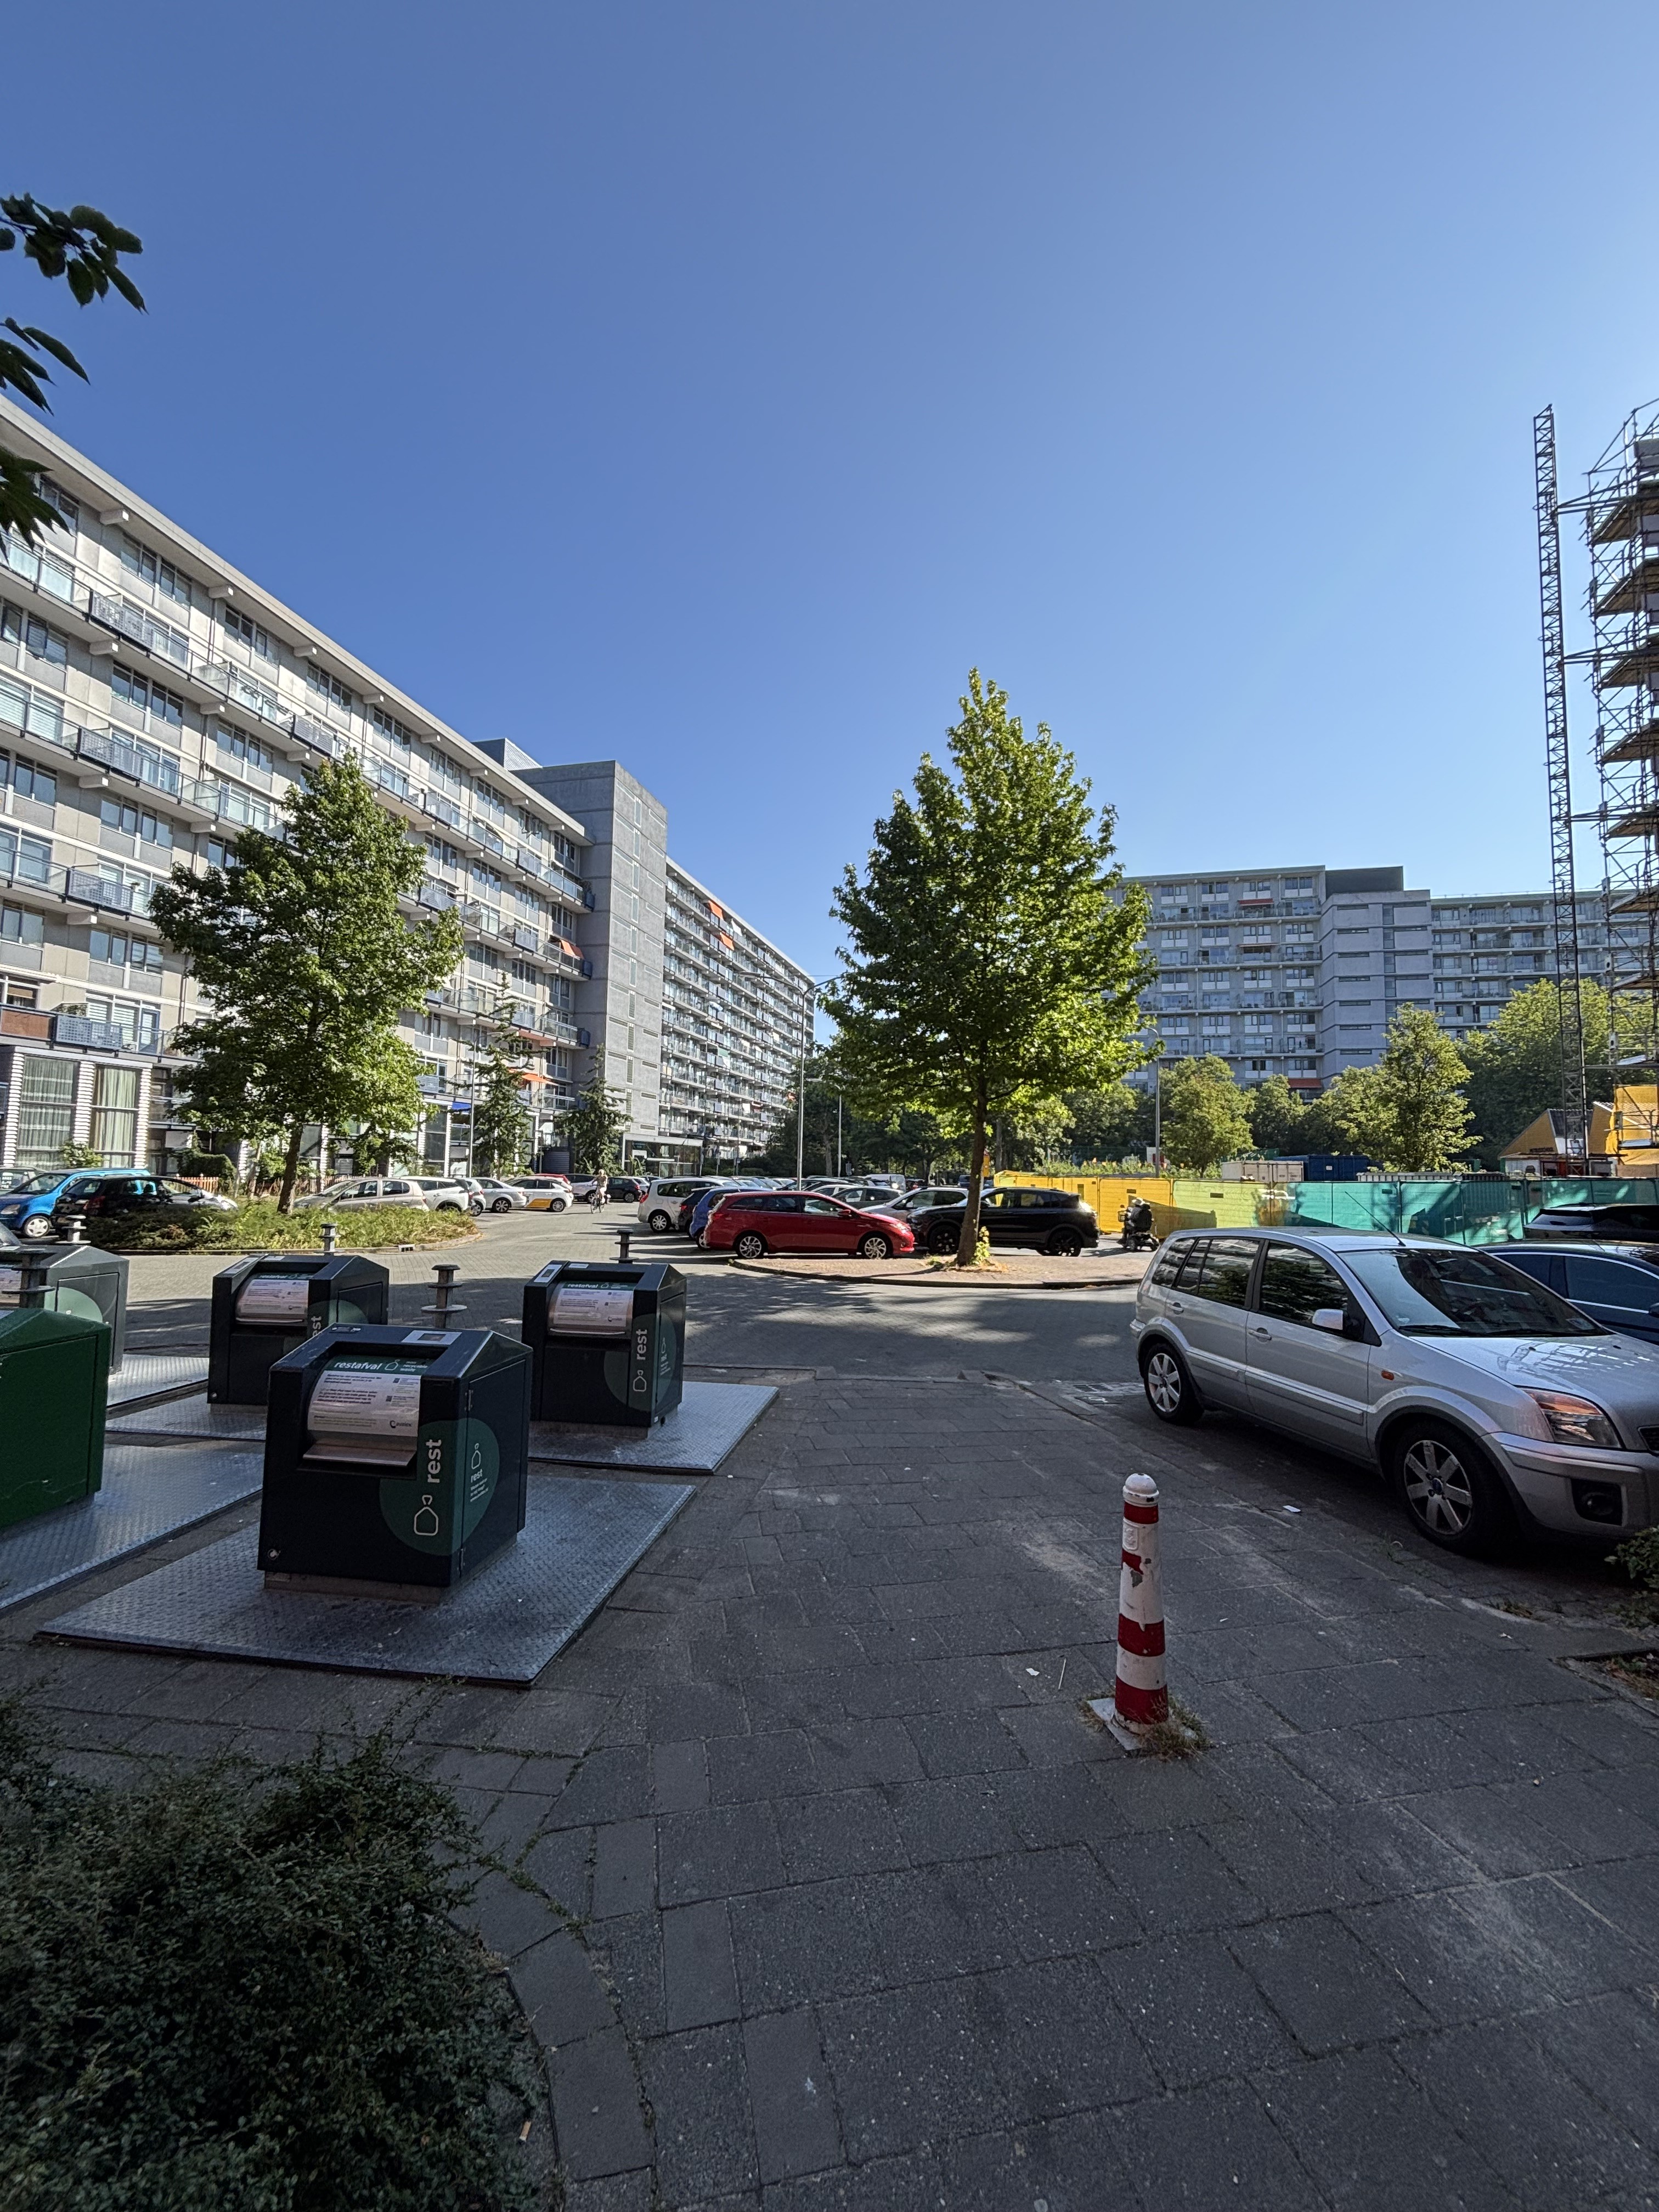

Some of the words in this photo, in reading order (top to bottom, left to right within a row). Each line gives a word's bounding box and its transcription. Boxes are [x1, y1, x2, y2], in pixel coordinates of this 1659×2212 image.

[636, 1329, 647, 1360] rest
[334, 1362, 383, 1370] restafval
[425, 1439, 442, 1483] rest
[471, 1469, 483, 1483] rest
